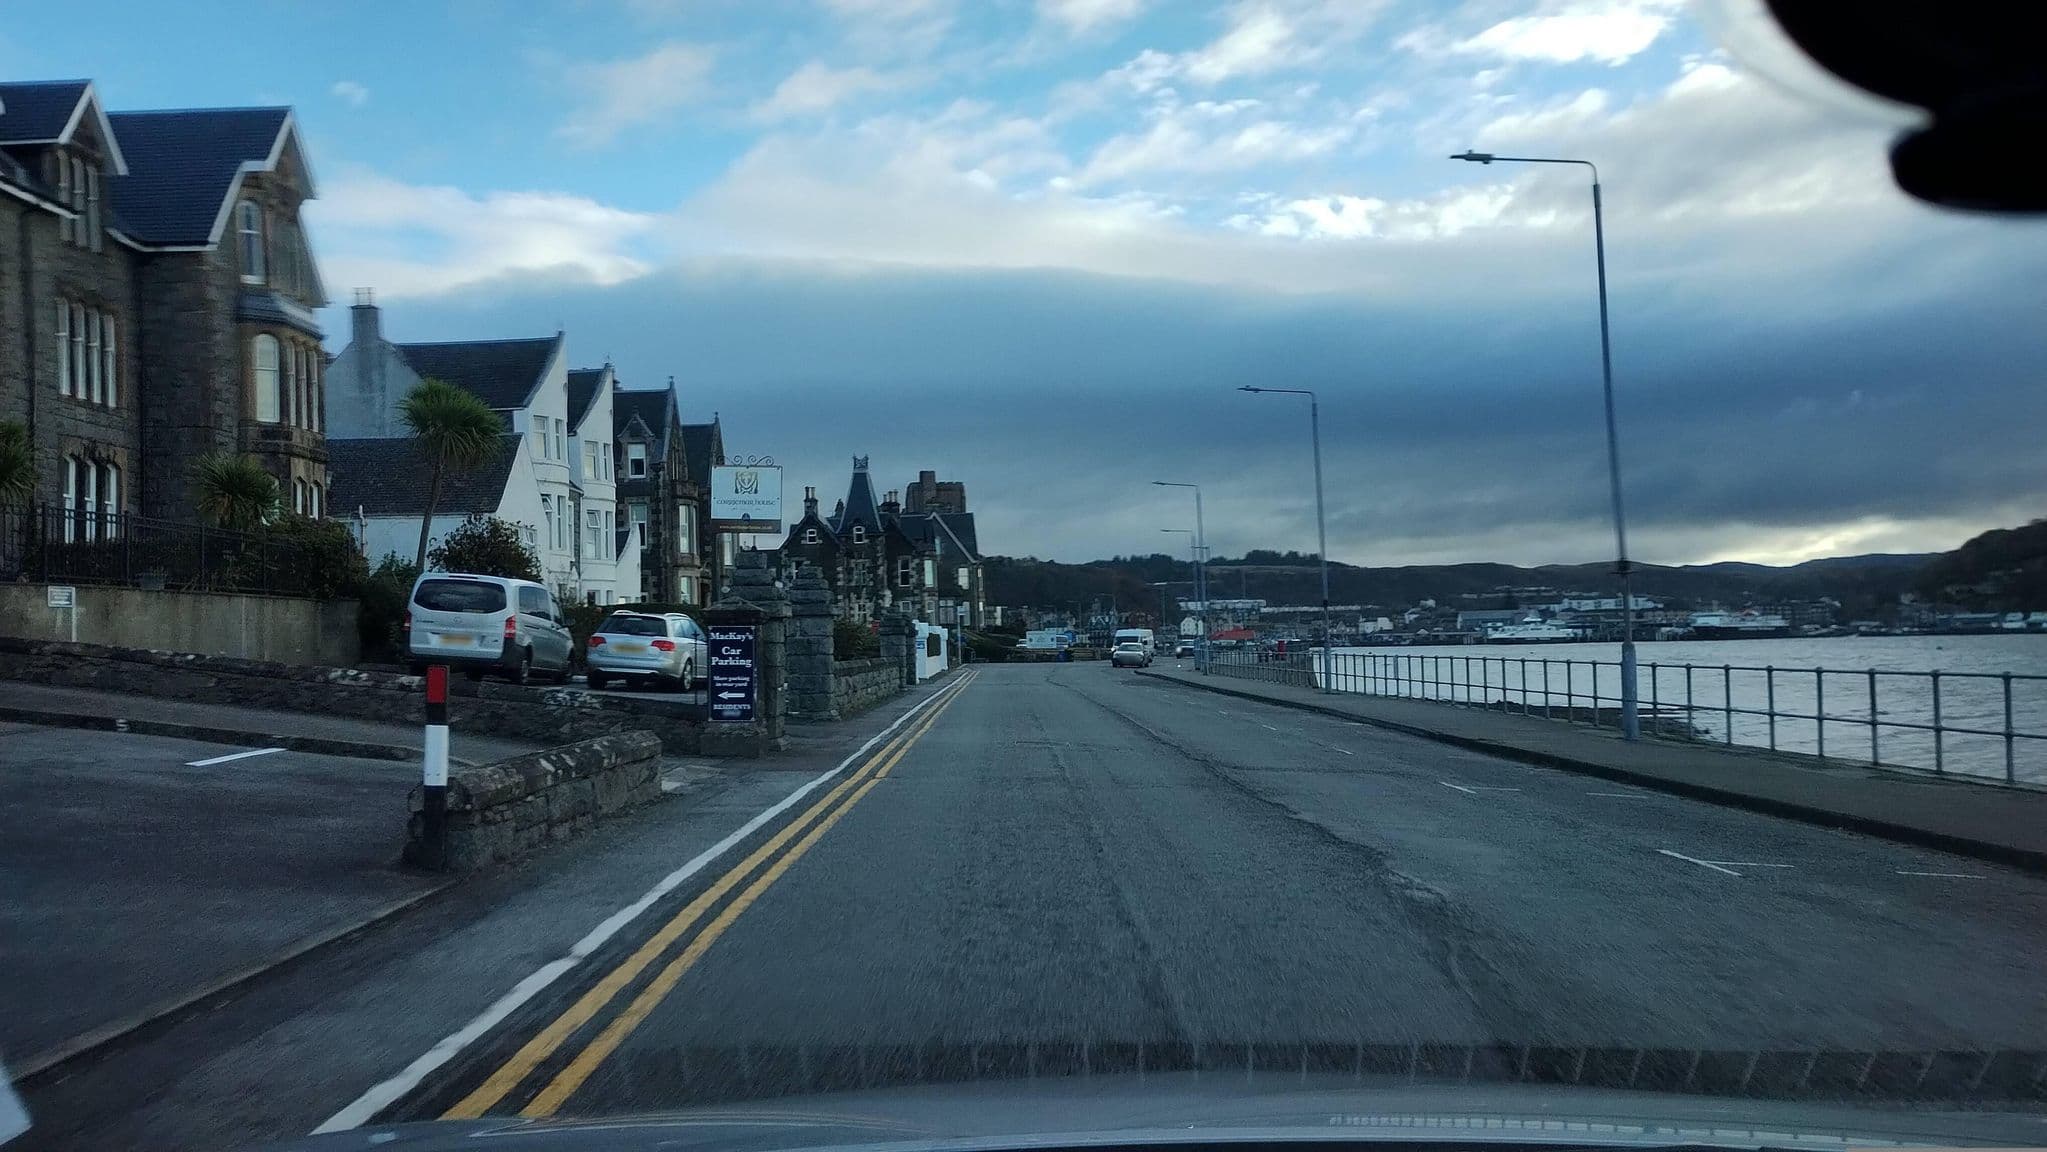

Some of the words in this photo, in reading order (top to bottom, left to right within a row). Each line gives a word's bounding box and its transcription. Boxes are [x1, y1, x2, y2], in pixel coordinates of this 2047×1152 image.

[709, 632, 754, 642] MacKay's
[721, 646, 742, 655] Car
[711, 657, 752, 668] Parking
